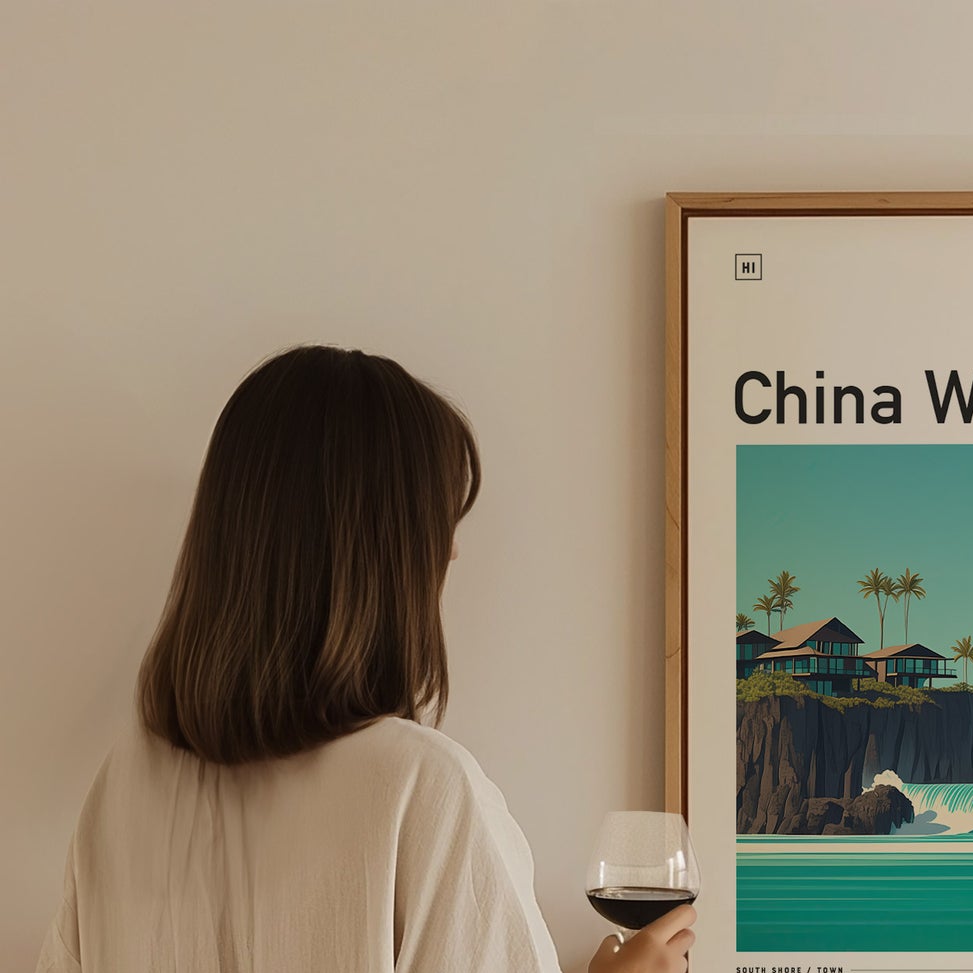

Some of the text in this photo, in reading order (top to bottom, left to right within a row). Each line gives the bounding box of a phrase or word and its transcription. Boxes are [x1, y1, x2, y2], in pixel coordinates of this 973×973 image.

[741, 262, 756, 274] HI
[734, 370, 902, 425] China
[736, 966, 767, 973] SOUTH
[771, 966, 802, 973] SHORE
[817, 966, 844, 973] TOWN
